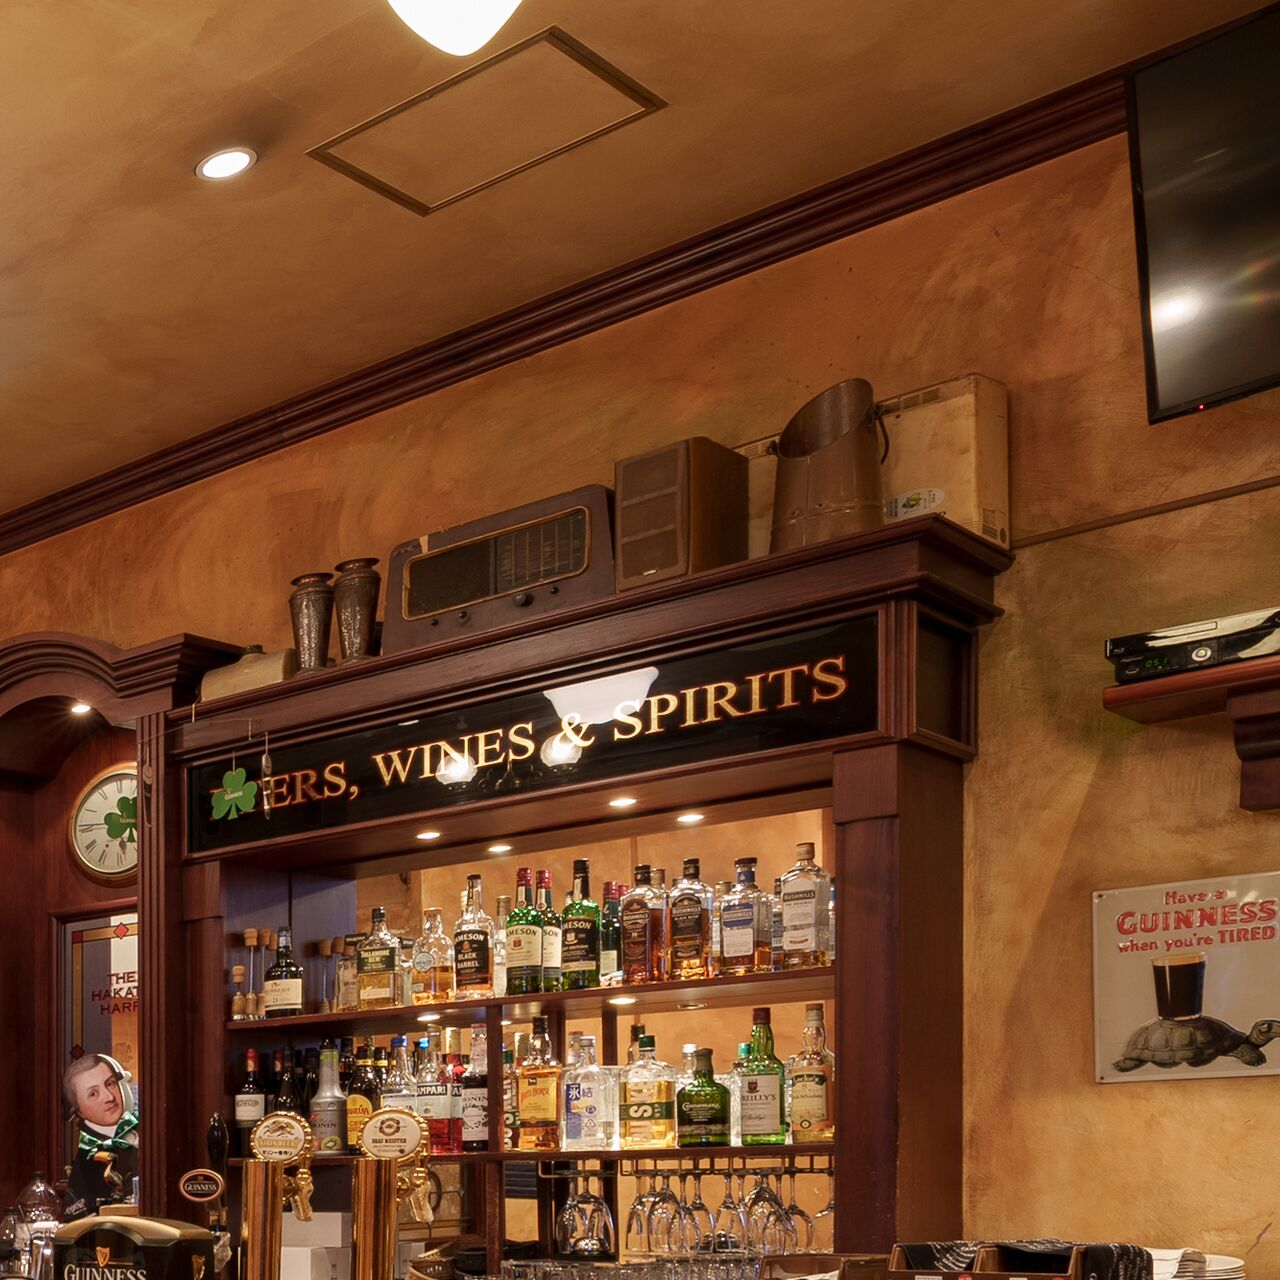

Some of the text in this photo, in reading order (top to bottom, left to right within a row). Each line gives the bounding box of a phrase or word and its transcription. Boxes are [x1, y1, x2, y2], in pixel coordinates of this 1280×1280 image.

[209, 654, 848, 821] ERS, WINES & SPIRITS
[784, 891, 815, 901] BUSHMILLS
[1164, 889, 1227, 905] Have a
[673, 906, 701, 914] BUSHMILLS
[723, 911, 753, 919] BUSHMILLS
[623, 912, 648, 921] BUSHMILLS
[1117, 898, 1278, 935] GUINNESS
[562, 920, 591, 930] AMESON
[506, 927, 537, 936] AMESON
[454, 932, 485, 942] AMESON
[1118, 925, 1277, 953] when you're TIRED
[457, 951, 477, 959] BLACK
[456, 960, 479, 969] BARREL
[106, 971, 137, 985] THE
[91, 986, 139, 1002] HAKAT
[417, 1085, 446, 1095] AMPARI
[184, 1182, 217, 1192] GUINNESS
